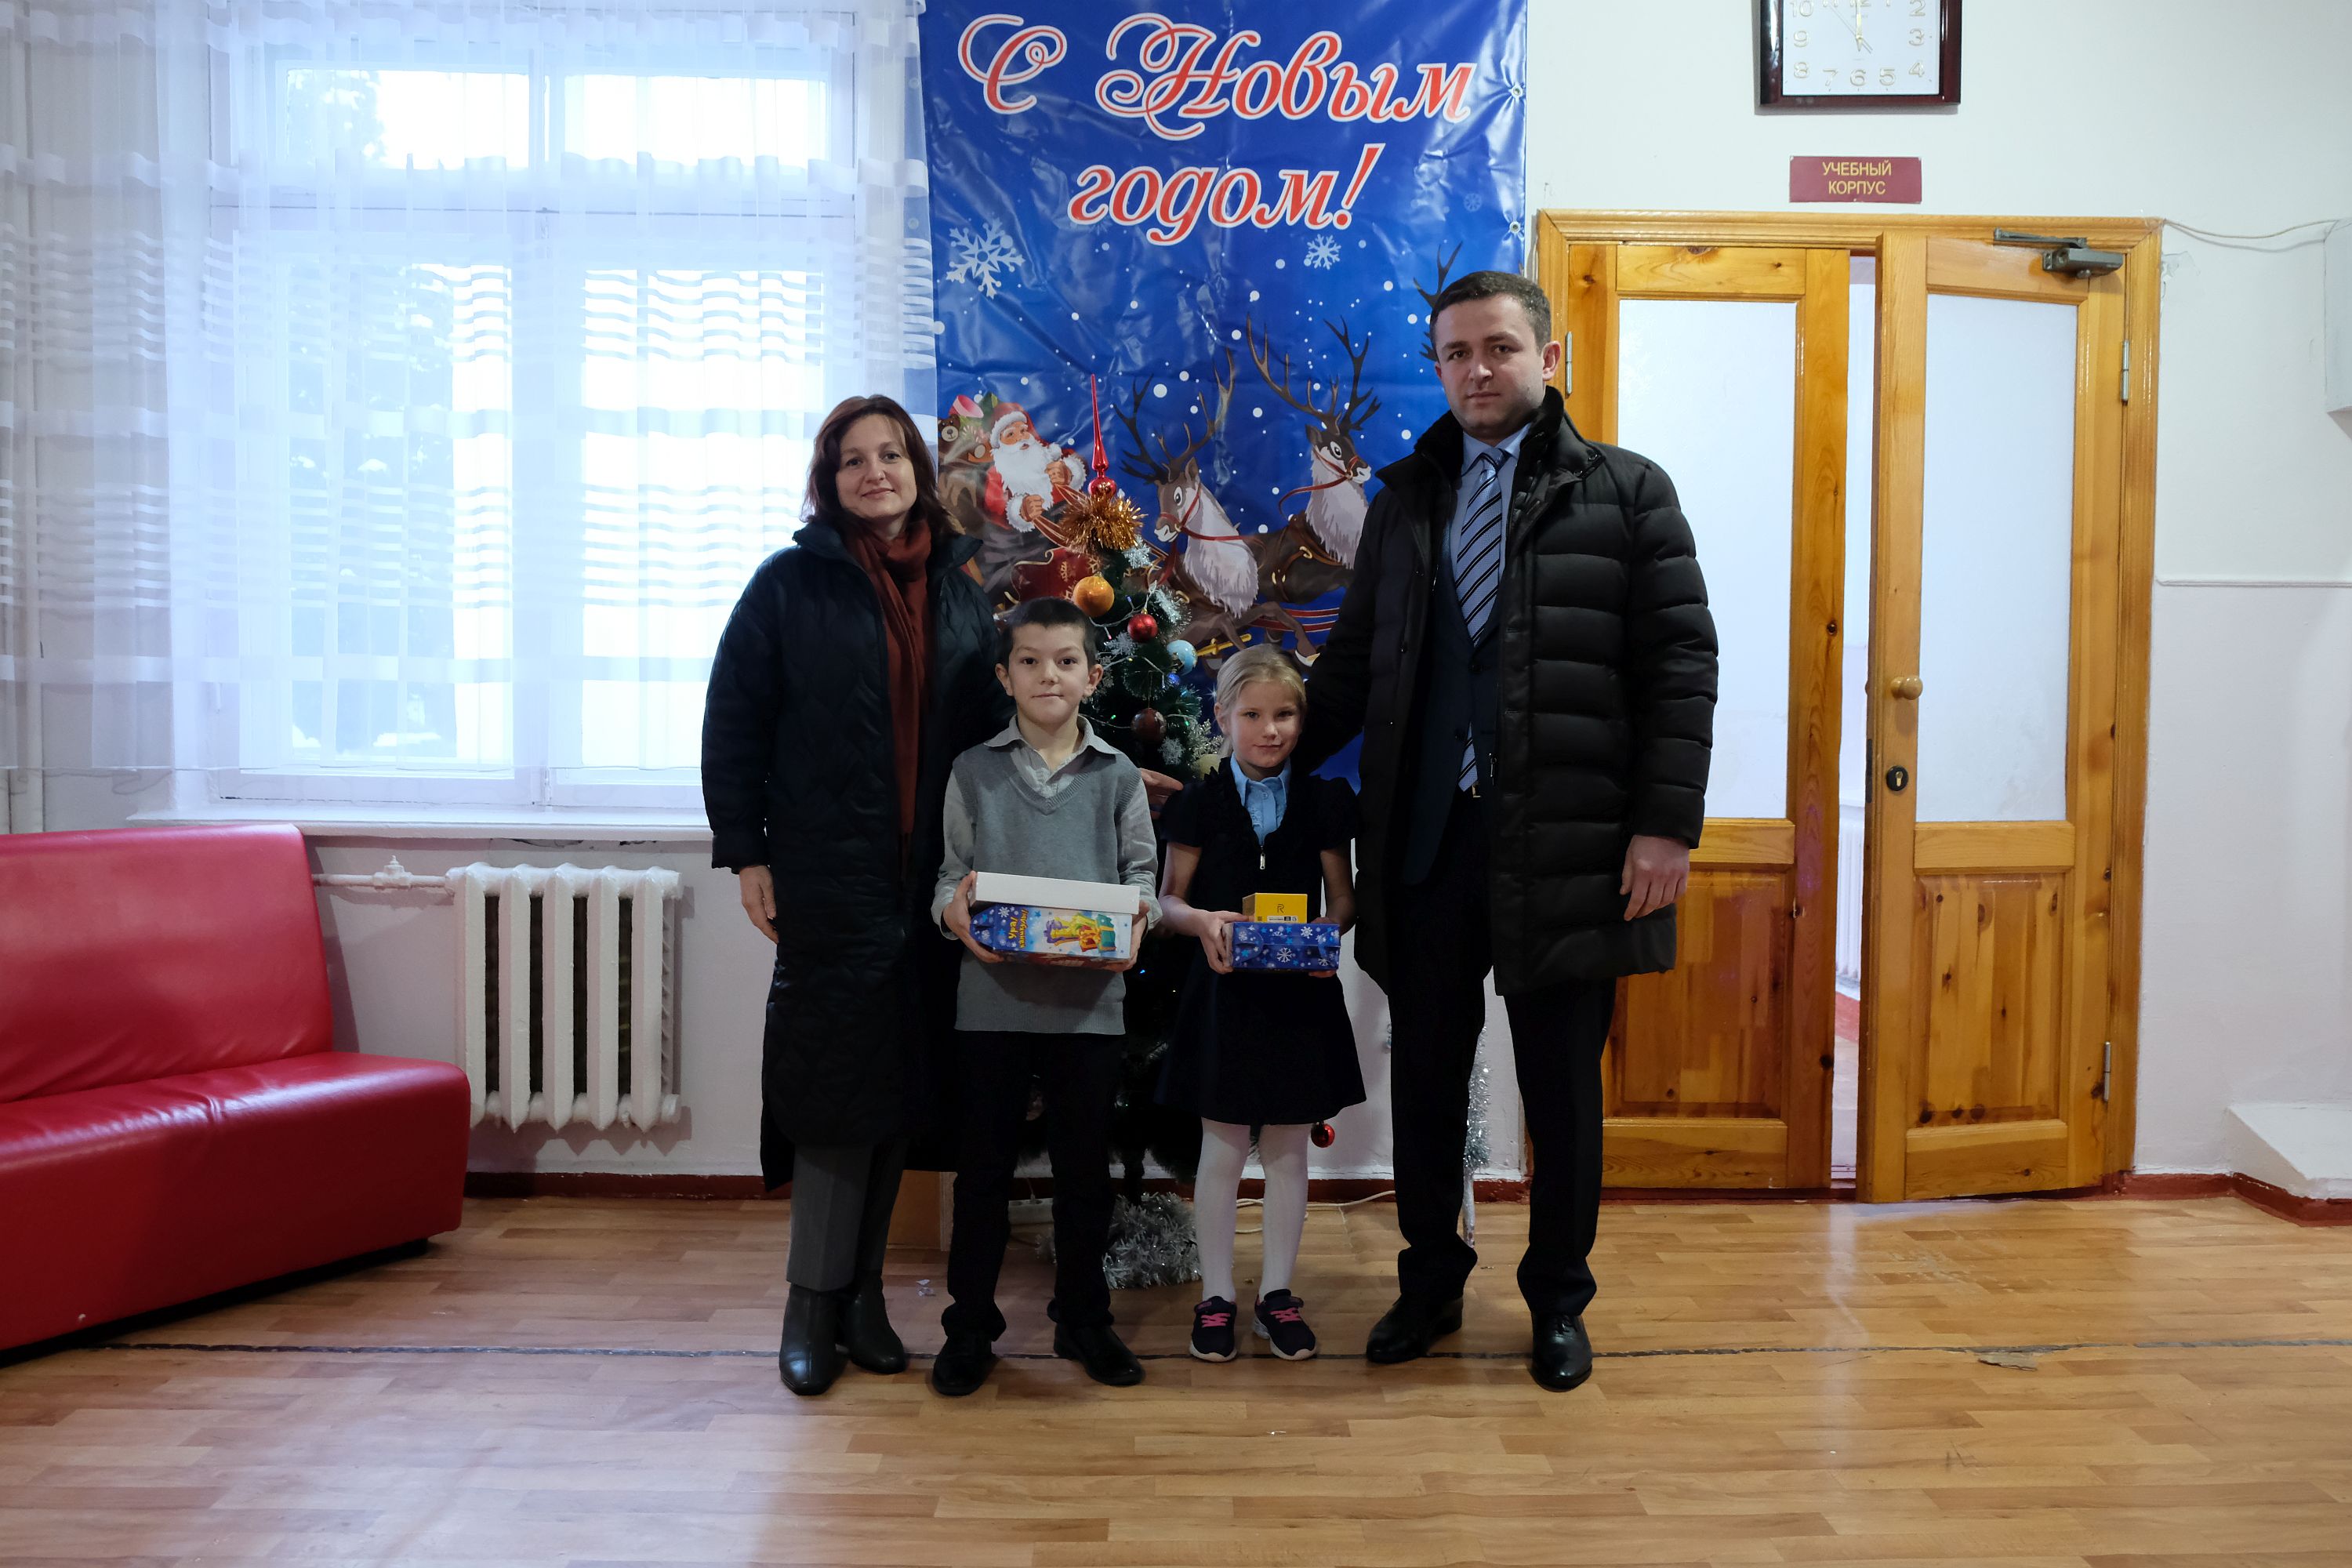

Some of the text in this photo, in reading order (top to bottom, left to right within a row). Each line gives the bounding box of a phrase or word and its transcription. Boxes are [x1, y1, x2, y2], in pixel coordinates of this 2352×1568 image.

[1790, 0, 1813, 17] 10
[1909, 0, 1926, 17] 2
[1793, 31, 1809, 47] 9
[1908, 28, 1926, 46] 3
[957, 13, 1479, 140] С Новым
[1793, 62, 1809, 78] 8
[1823, 69, 1838, 86] 7
[1849, 69, 1866, 86] 6
[1879, 68, 1896, 86] 5
[1908, 61, 1926, 78] 4
[1822, 160, 1892, 176] УЧЕБНЫЙ
[1069, 143, 1387, 246] годом!
[1828, 180, 1886, 194] КОРПУС
[1008, 916, 1018, 939] Ура!
